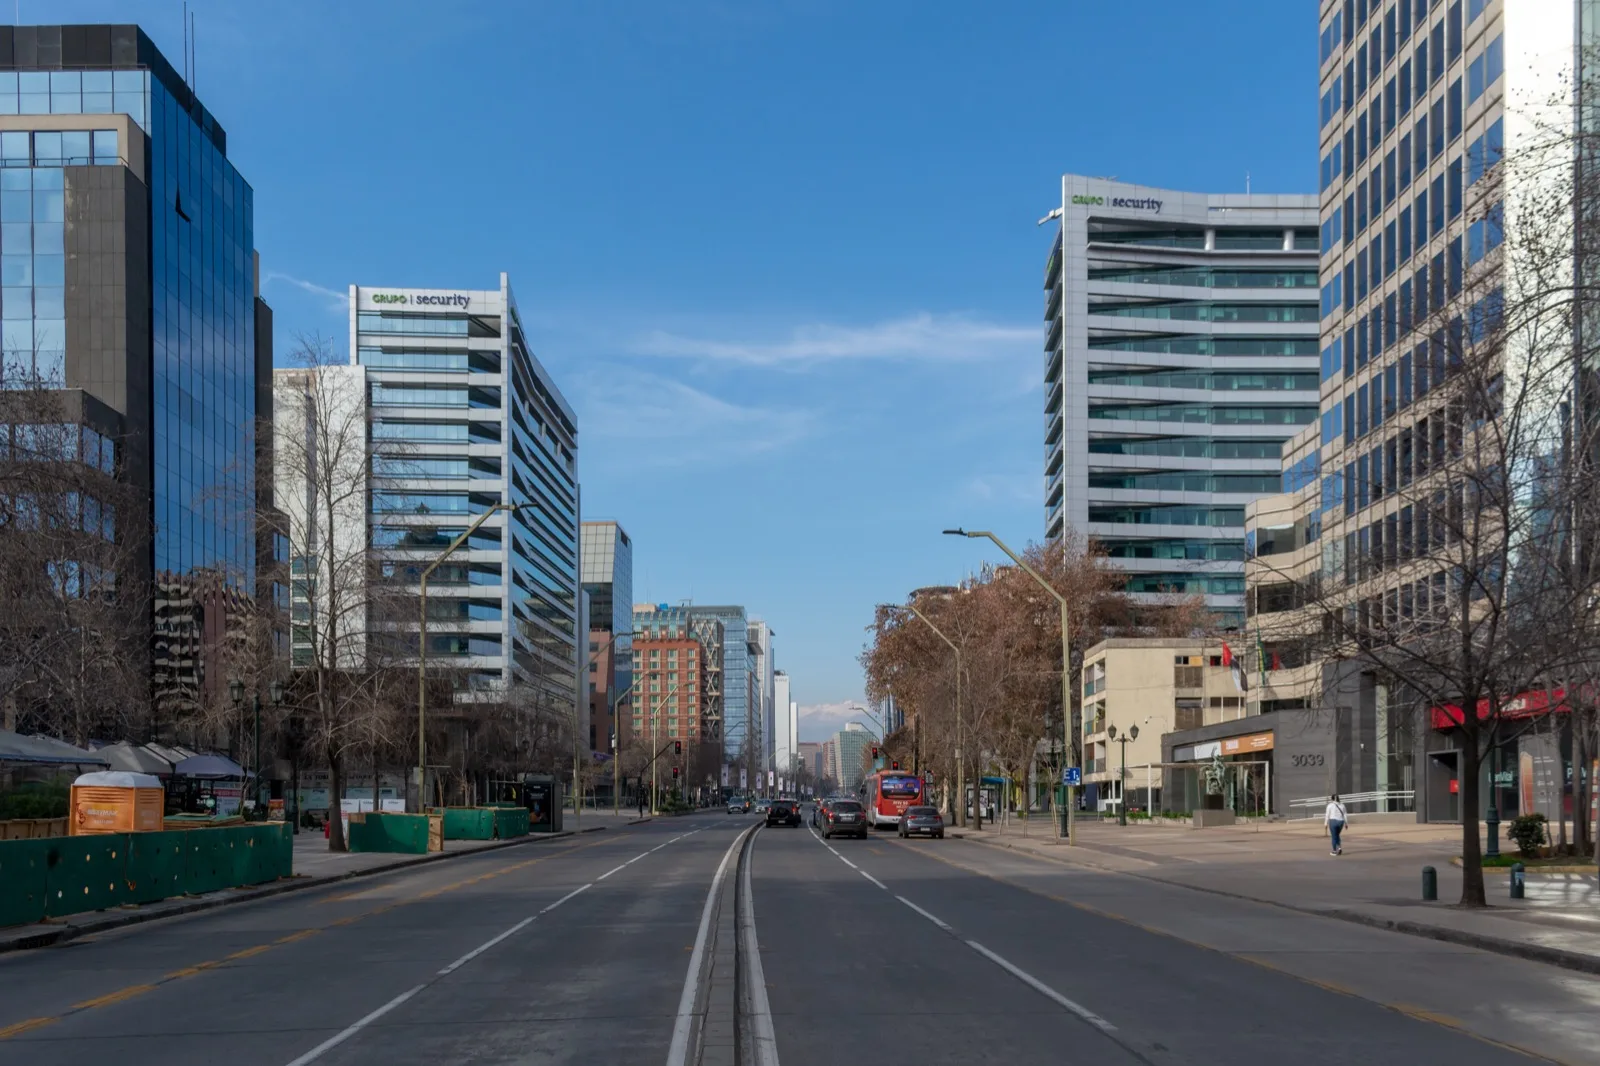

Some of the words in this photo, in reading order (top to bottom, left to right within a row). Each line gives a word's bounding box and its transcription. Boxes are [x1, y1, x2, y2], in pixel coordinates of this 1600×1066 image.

[1071, 195, 1104, 206] GRUPO
[1112, 197, 1162, 213] security
[372, 294, 408, 305] GRUPO
[416, 294, 471, 309] security
[1291, 754, 1325, 767] 3039
[1063, 769, 1071, 780] E
